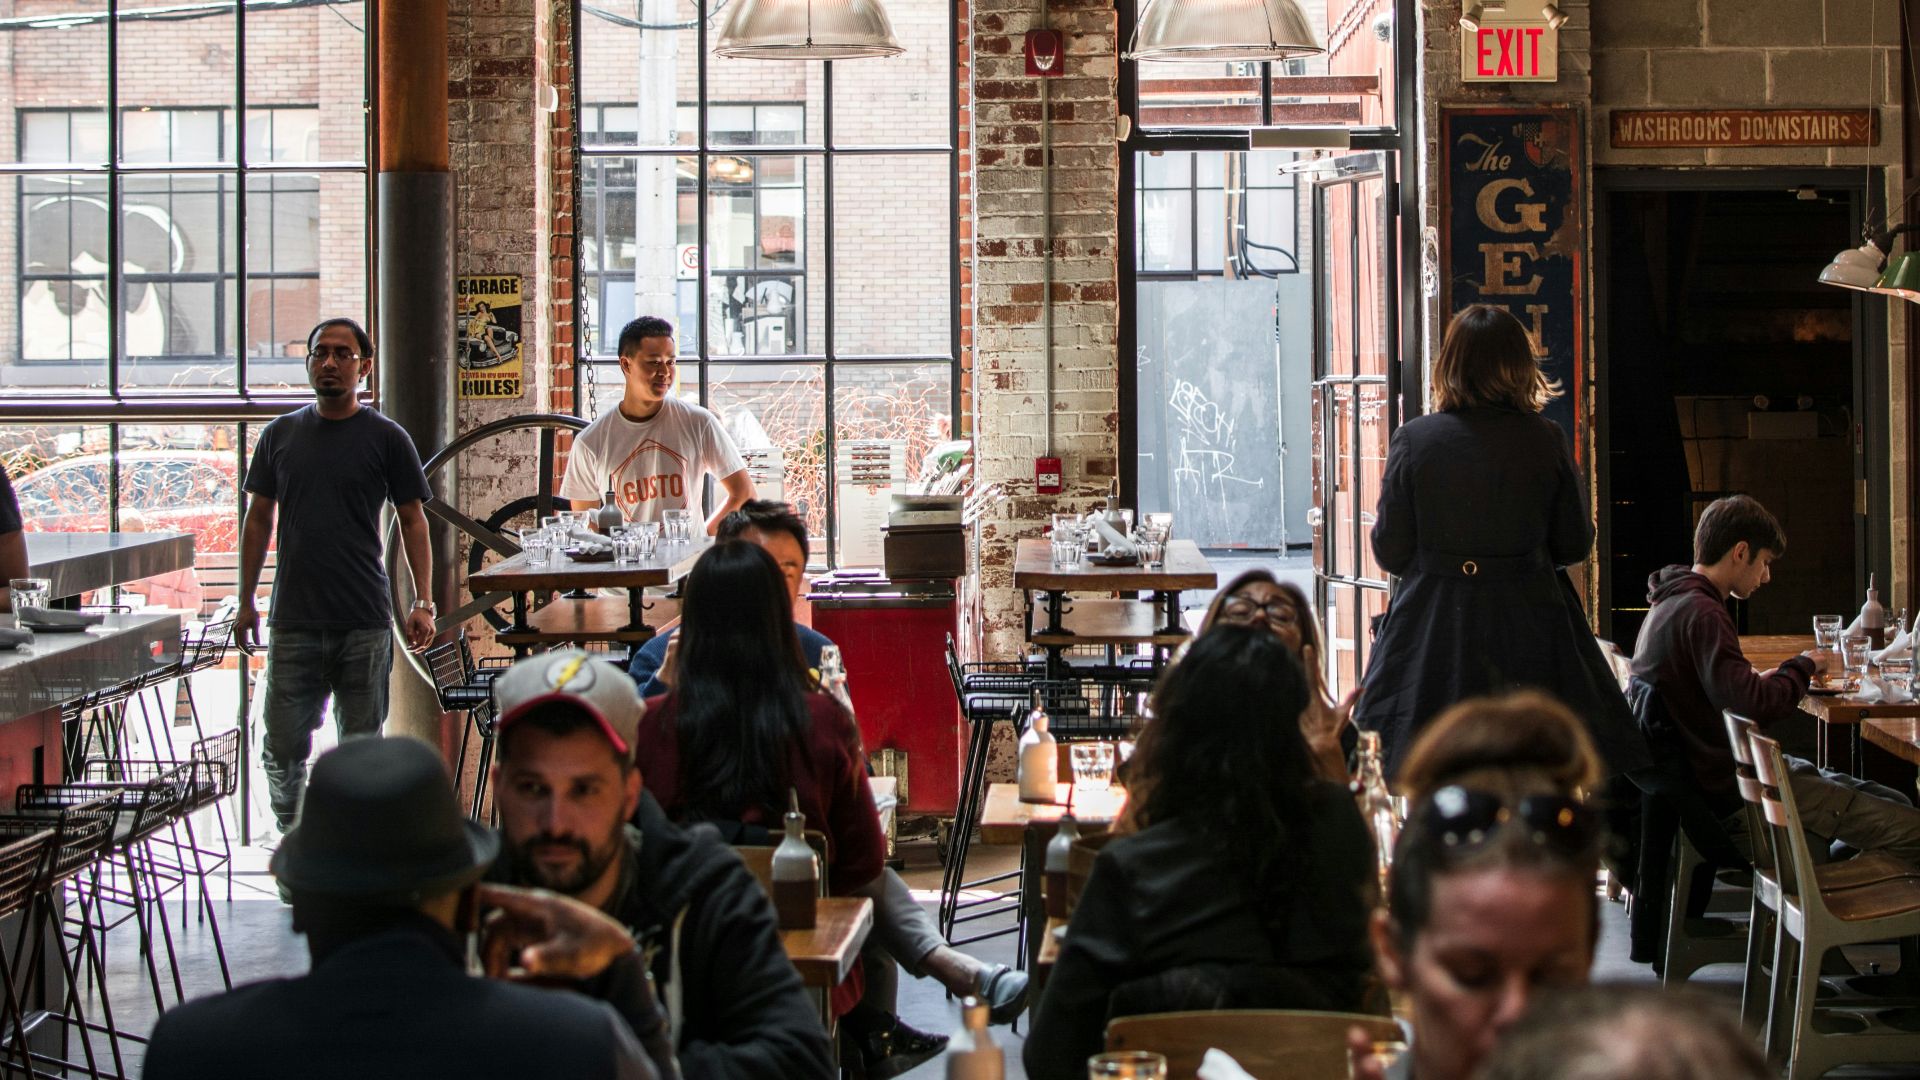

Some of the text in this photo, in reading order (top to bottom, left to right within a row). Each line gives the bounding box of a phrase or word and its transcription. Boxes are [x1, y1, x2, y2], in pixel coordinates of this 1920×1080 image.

[1477, 28, 1544, 76] EXIT
[1619, 115, 1851, 142] WASHROOMS DOWNSTAIRS
[1458, 132, 1512, 172] The
[458, 279, 519, 295] GARAGE
[462, 379, 520, 396] RULES!
[623, 473, 684, 505] GUSTO
